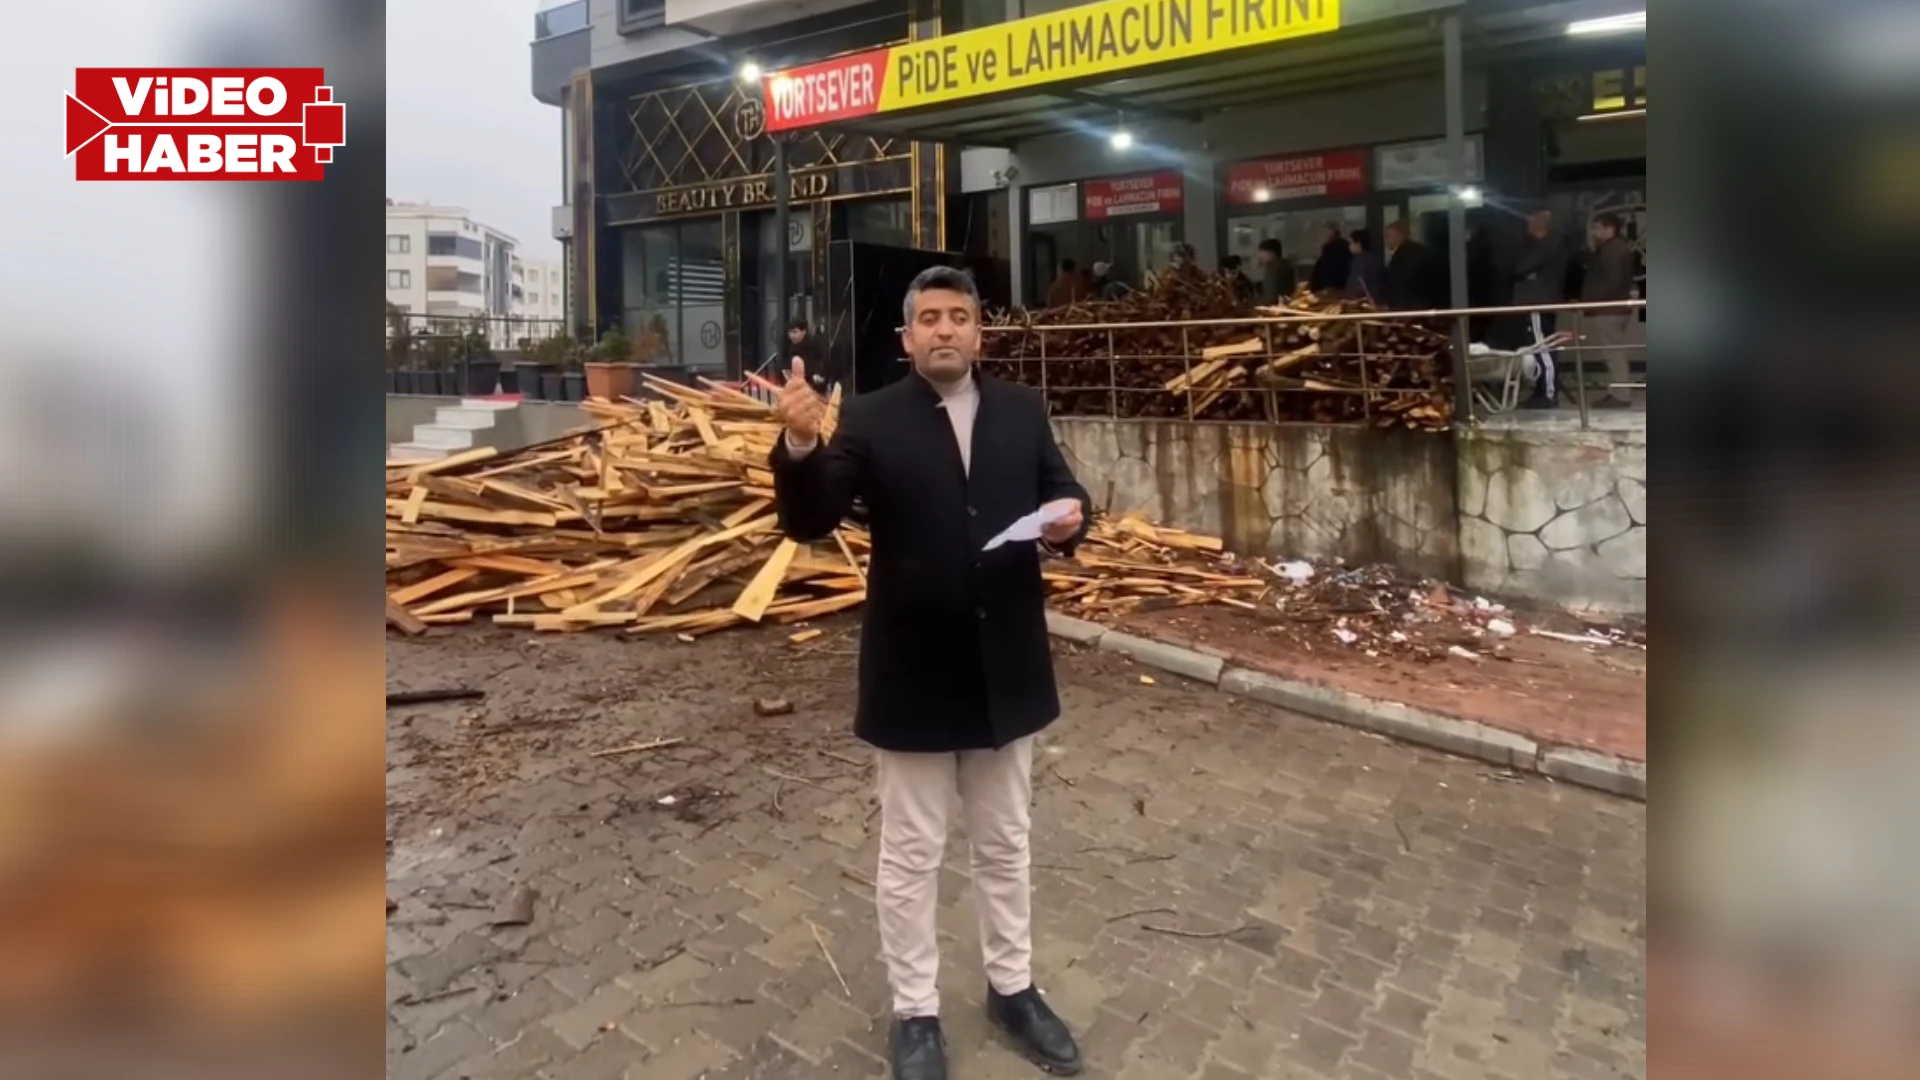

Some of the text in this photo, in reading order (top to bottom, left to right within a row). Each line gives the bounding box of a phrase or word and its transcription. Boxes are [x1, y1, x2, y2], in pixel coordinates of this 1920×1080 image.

[770, 63, 875, 121] YURTSEVER
[966, 48, 997, 84] ve
[1007, 0, 1192, 77] LAHMACUN
[656, 174, 828, 213] BEAUTY BRND
